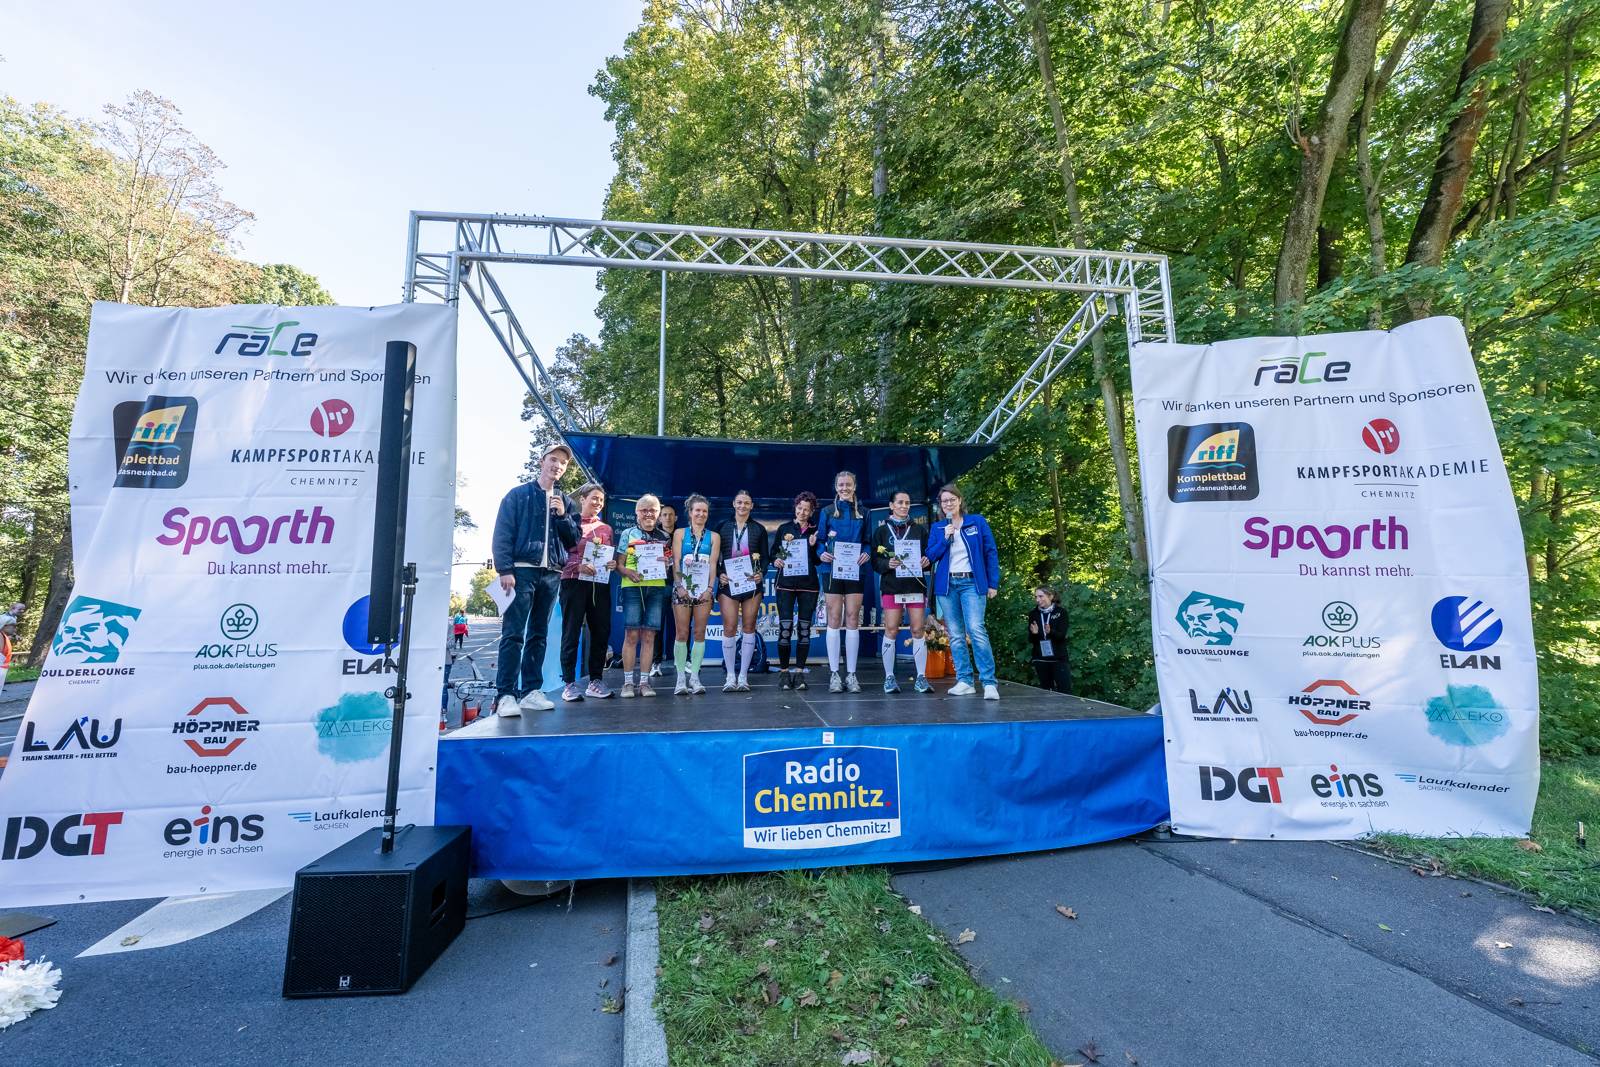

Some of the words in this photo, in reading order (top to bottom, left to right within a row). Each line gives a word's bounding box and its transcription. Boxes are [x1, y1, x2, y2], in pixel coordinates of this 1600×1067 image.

[106, 371, 137, 385] Wir
[144, 368, 186, 384] dken
[191, 368, 248, 381] unseren
[253, 369, 314, 382] Partnern
[320, 370, 345, 382] und
[351, 370, 431, 384] Spoen
[1162, 399, 1183, 411] Wir
[1185, 398, 1231, 412] danken
[1235, 396, 1290, 409] unseren
[1294, 393, 1354, 406] Partnern
[1359, 391, 1385, 404] und
[1389, 382, 1476, 405] Sponsoren
[133, 422, 178, 439] riff
[122, 454, 180, 465] plettbad
[231, 449, 426, 465] KAMPFSPORTAKAIE
[1198, 445, 1235, 460] riff
[1297, 459, 1489, 480] KAMPFSPORTAKADEMIE
[291, 477, 359, 486] CHEMNITZ
[1177, 472, 1246, 484] Komplettbad
[1177, 484, 1247, 493] www.dasneuebad.de
[1361, 489, 1415, 499] CHEMNITZ
[207, 562, 226, 576] Du
[230, 561, 282, 575] kannst
[286, 561, 331, 574] mehr.
[1299, 564, 1318, 577] Du
[1321, 563, 1371, 577] kannst
[1375, 563, 1414, 577] mehr.
[1177, 648, 1249, 657] BOULDERLOUNGE
[1302, 651, 1380, 659] plus.aok.de/leistungen
[193, 662, 276, 671] plus.aok.de/leistungen
[1440, 654, 1501, 670] ELAN
[41, 668, 136, 677] OULDERLOUNGE
[1189, 688, 1253, 715] LAU
[1288, 695, 1371, 710] HÖPPNER
[1317, 709, 1340, 717] BAU
[172, 718, 260, 734] HÖPPNER
[22, 717, 123, 752] LAU
[203, 736, 227, 744] BAU
[1294, 729, 1368, 740] bau-hoeppner.de
[167, 762, 257, 774] bau-hoeppner.de
[785, 758, 860, 784] Radio
[1199, 766, 1284, 803] DGT
[1311, 764, 1384, 798] eins
[1418, 775, 1511, 793] Laufkalender
[754, 783, 891, 813] Chemnitz.
[1358, 800, 1389, 808] sachsen
[315, 808, 401, 821] Laufkalenr
[164, 805, 264, 846] eins
[313, 823, 349, 831] SACHSEN
[754, 830, 777, 843] Wir
[781, 827, 822, 841] lieben
[826, 822, 891, 837] Chemnitz!
[2, 811, 124, 860] DGT
[163, 849, 204, 859] energie
[207, 847, 217, 856] in
[220, 844, 264, 855] sachsen
